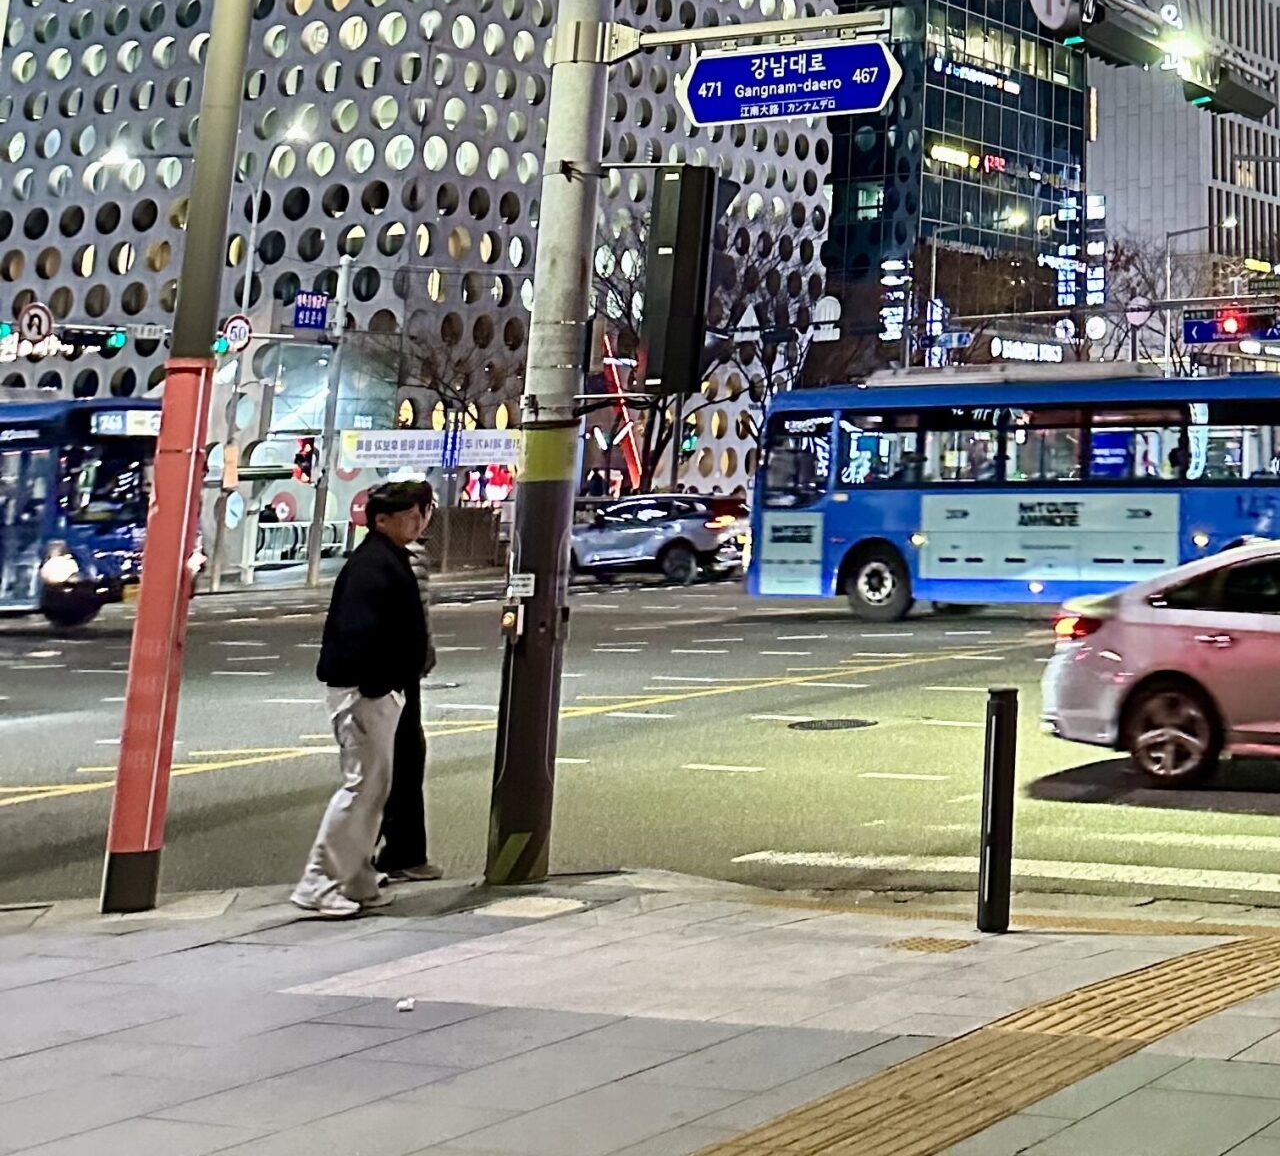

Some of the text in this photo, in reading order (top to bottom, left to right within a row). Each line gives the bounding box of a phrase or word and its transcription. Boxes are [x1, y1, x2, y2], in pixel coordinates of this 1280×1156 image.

[751, 54, 826, 79] 강남대로
[852, 67, 879, 84] 467
[698, 82, 722, 98] 471
[734, 78, 842, 99] Gangnam-daero
[740, 104, 779, 118] 江南大路
[229, 326, 246, 342] 50
